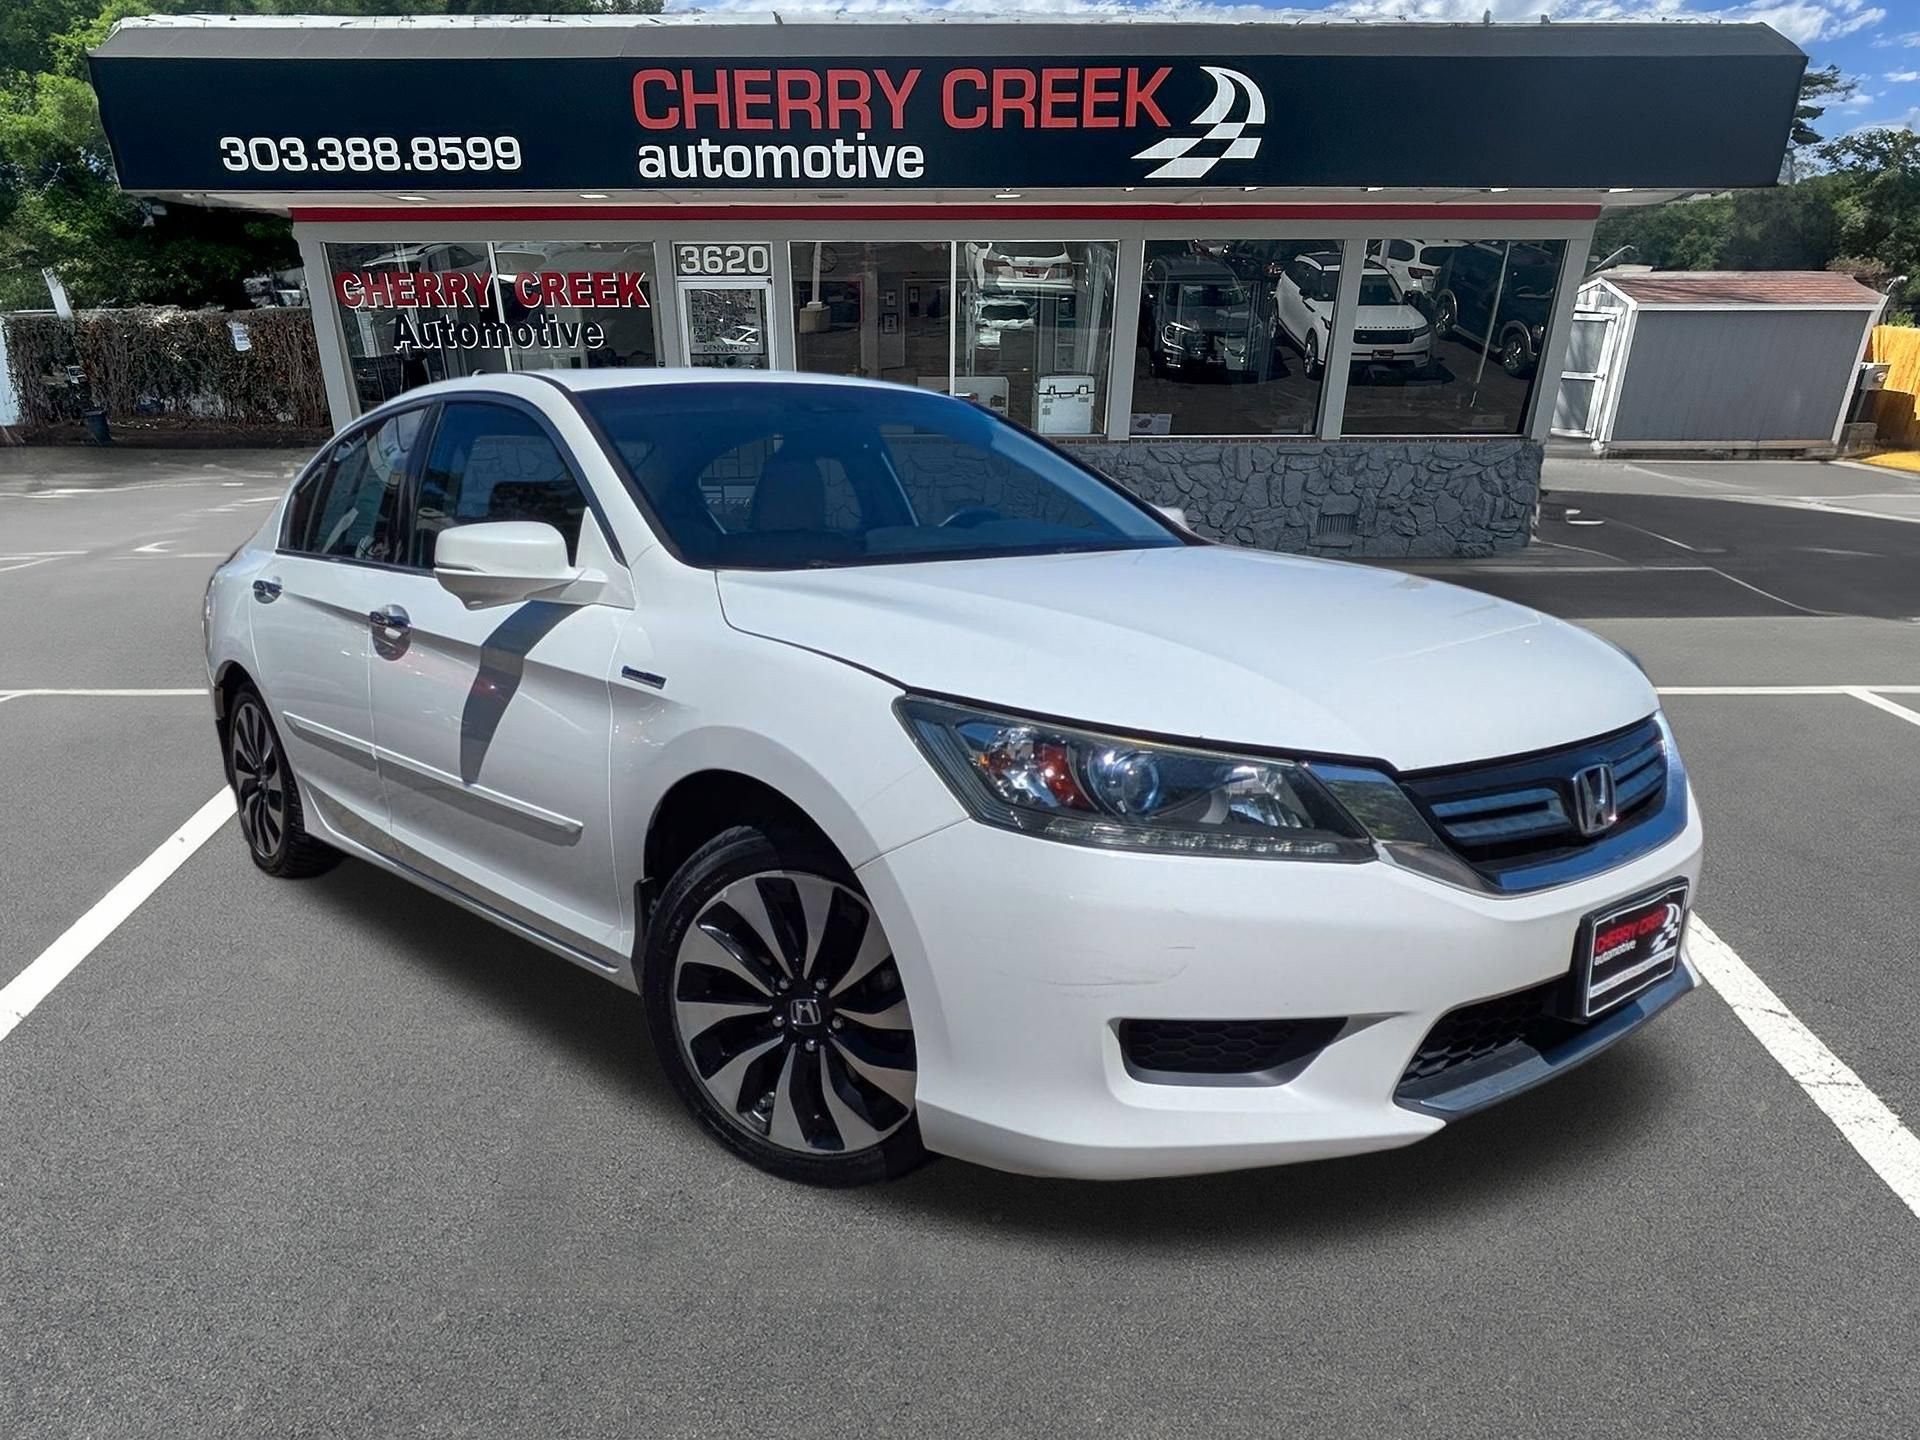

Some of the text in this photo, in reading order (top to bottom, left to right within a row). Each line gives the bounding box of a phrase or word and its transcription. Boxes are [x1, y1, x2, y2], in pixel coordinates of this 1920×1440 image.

[633, 67, 1172, 130] CHERRY CREEK
[219, 136, 523, 172] 303.388.8599
[638, 132, 925, 180] automotive
[679, 245, 769, 274] 3620
[334, 271, 650, 309] CHERRY CREEK
[393, 314, 606, 351] Automotive
[1594, 939, 1637, 967] automotive
